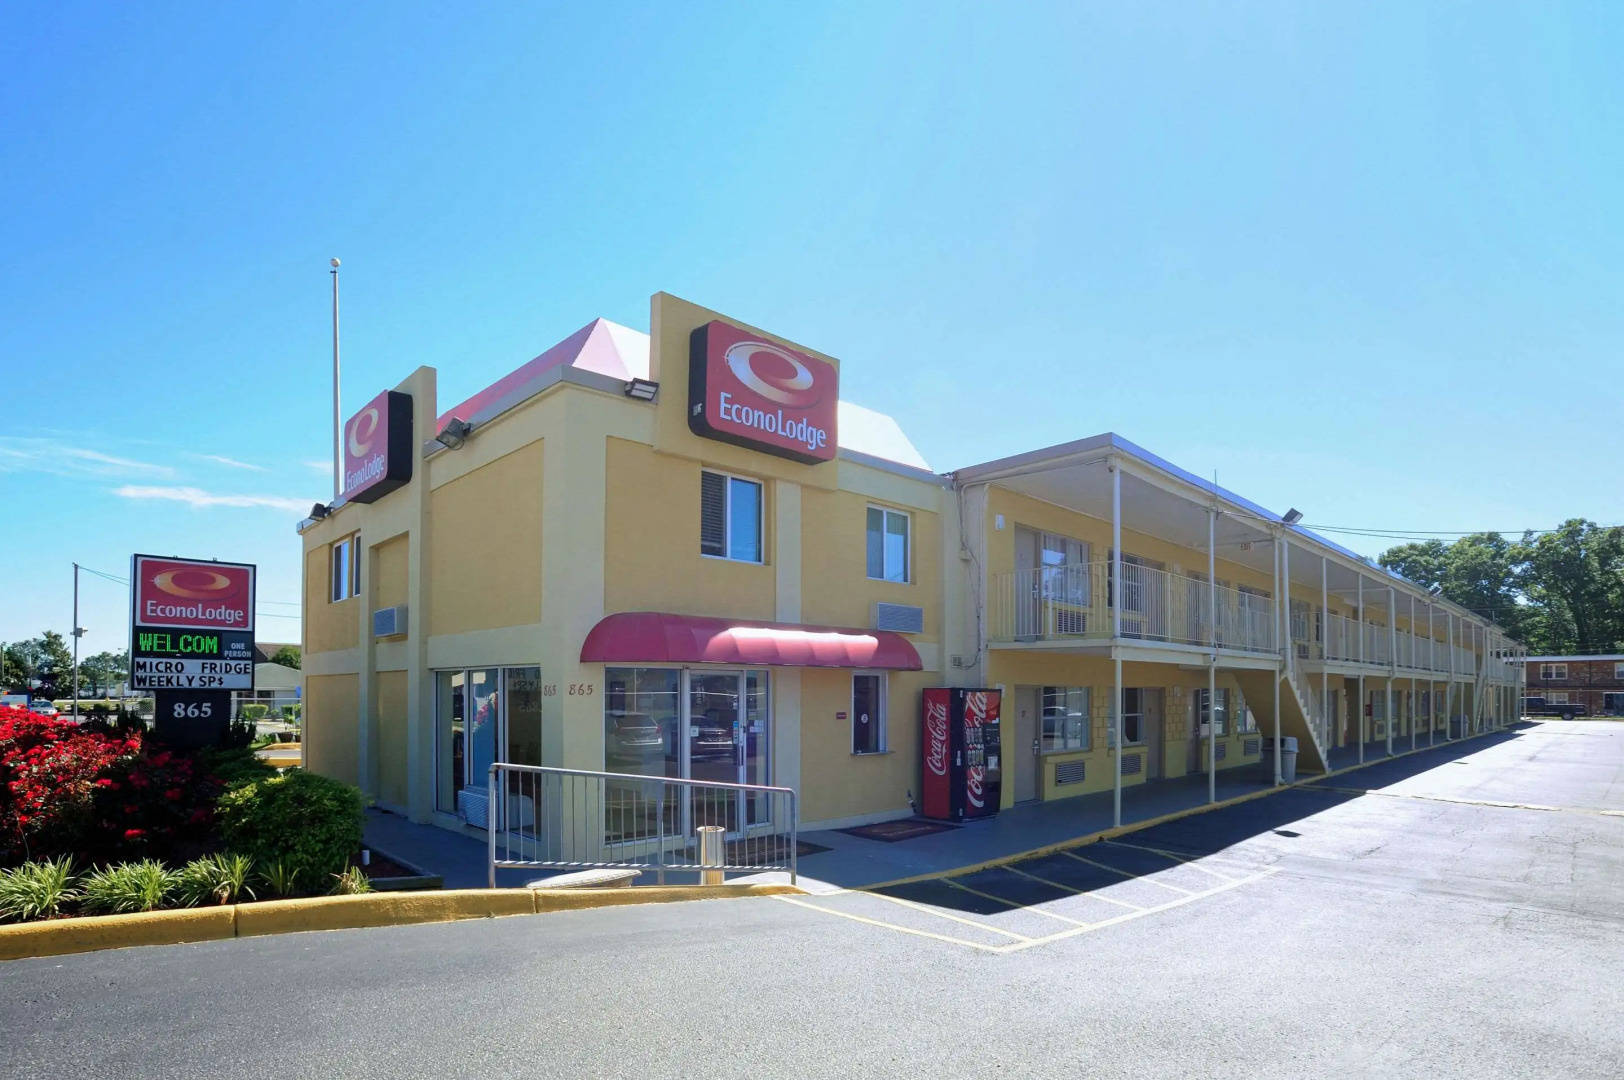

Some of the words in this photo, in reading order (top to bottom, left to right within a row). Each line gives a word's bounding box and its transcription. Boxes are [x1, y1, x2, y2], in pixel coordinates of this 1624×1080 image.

[719, 391, 827, 450] EconoLodge
[346, 453, 385, 492] EconoLodge
[146, 600, 244, 623] EconoLodge
[139, 633, 218, 654] WELCOM
[231, 642, 246, 650] ONE
[224, 650, 252, 658] PERSON
[135, 661, 185, 673] MICRO
[201, 662, 251, 674] FRIDGE
[135, 675, 195, 687] WEEKLY
[199, 675, 224, 687] SP$
[543, 684, 557, 697] 865
[568, 683, 594, 696] 865
[173, 702, 212, 718] 865
